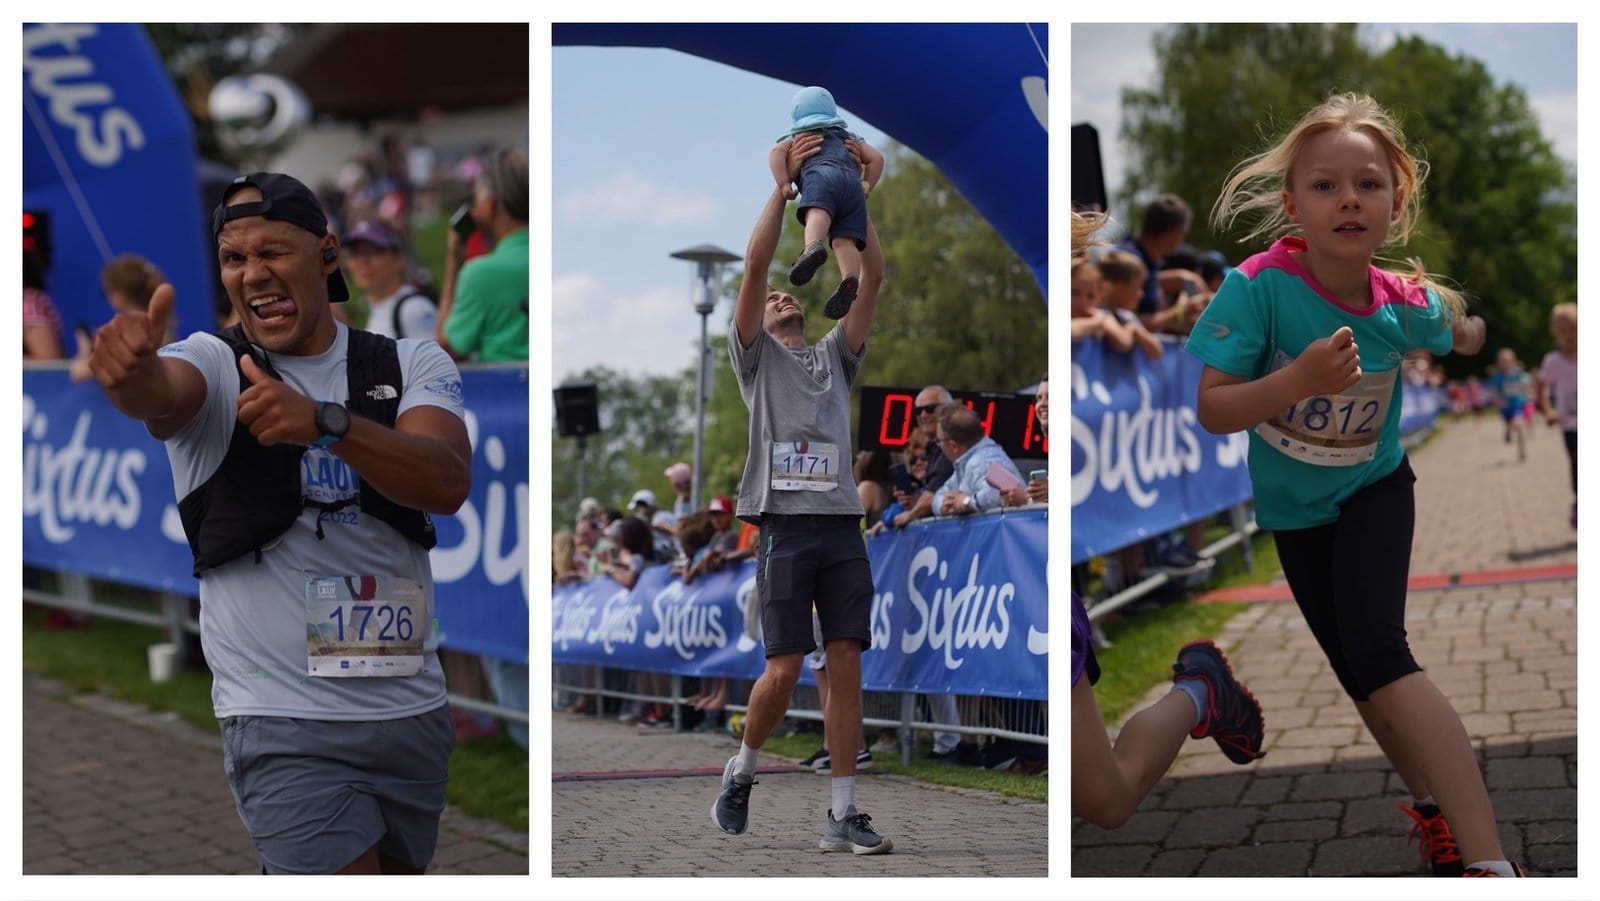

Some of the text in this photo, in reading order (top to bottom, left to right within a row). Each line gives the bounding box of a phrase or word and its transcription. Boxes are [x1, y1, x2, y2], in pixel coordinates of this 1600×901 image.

[1286, 397, 1379, 433] 1812
[23, 394, 147, 544] ixtus
[783, 456, 828, 475] 1171
[329, 605, 413, 642] 1726
[902, 546, 1015, 670] Sixtus
